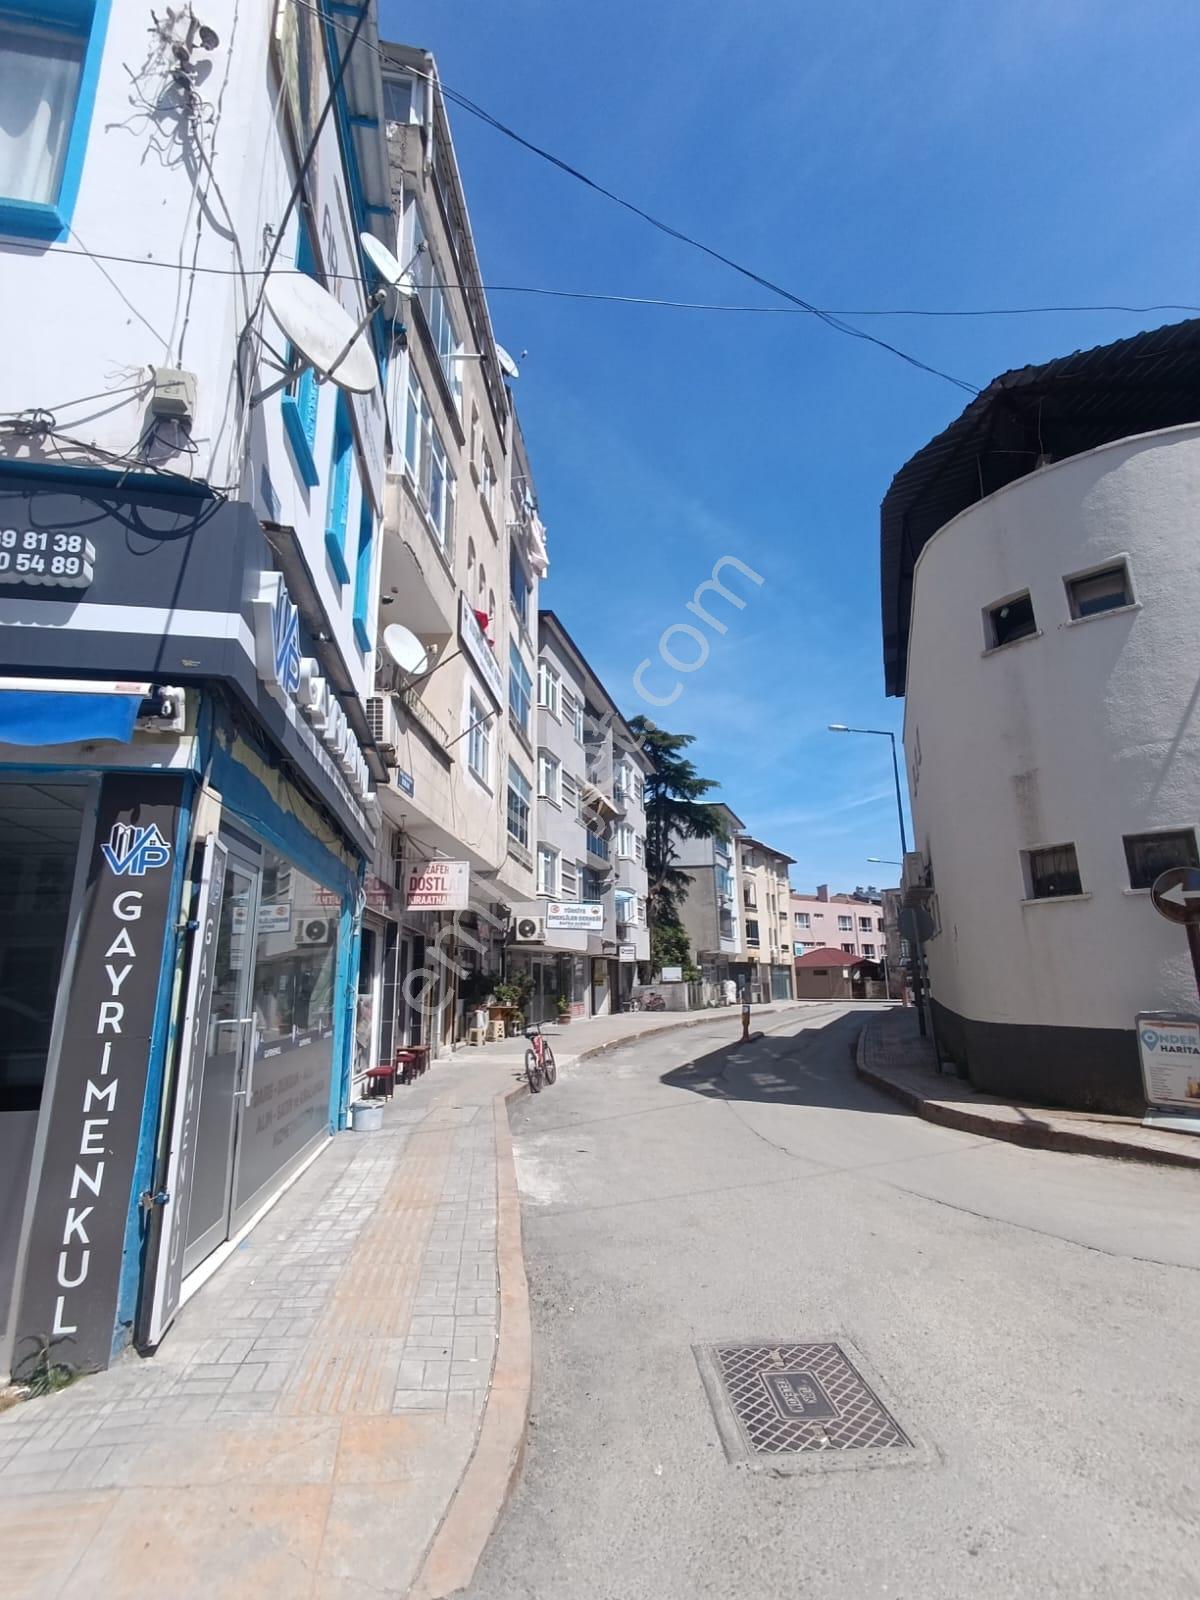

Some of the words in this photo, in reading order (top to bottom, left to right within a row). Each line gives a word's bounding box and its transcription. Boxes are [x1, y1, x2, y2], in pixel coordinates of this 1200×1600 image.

[0, 529, 17, 548] 9
[23, 531, 48, 551] 81
[53, 534, 82, 553] 38
[16, 553, 45, 573] 54
[51, 556, 80, 575] 89
[100, 823, 171, 876] VIP
[53, 890, 144, 1335] GAYRİMENKUL
